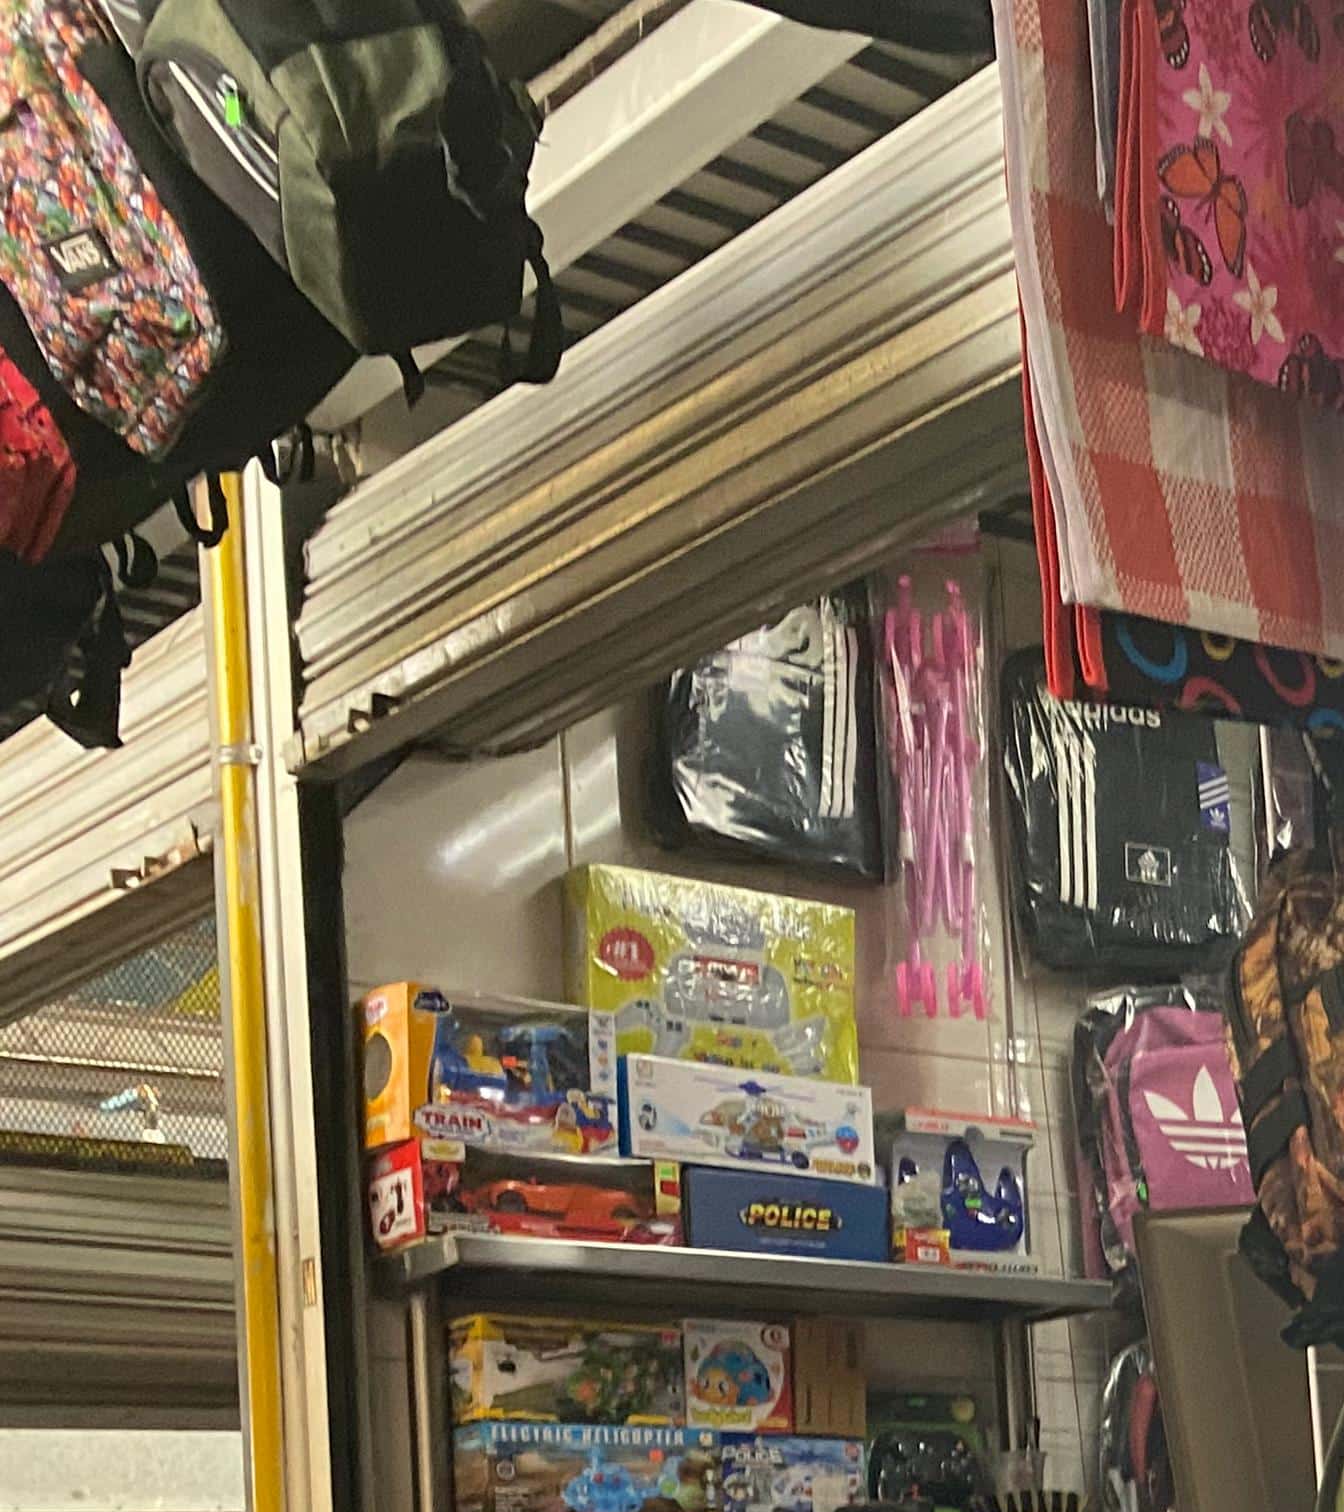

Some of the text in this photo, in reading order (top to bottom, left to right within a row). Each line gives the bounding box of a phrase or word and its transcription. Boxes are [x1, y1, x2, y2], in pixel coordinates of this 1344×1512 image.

[50, 233, 100, 273] VANS
[421, 1110, 482, 1131] TRAIN
[748, 1202, 833, 1231] POLICE
